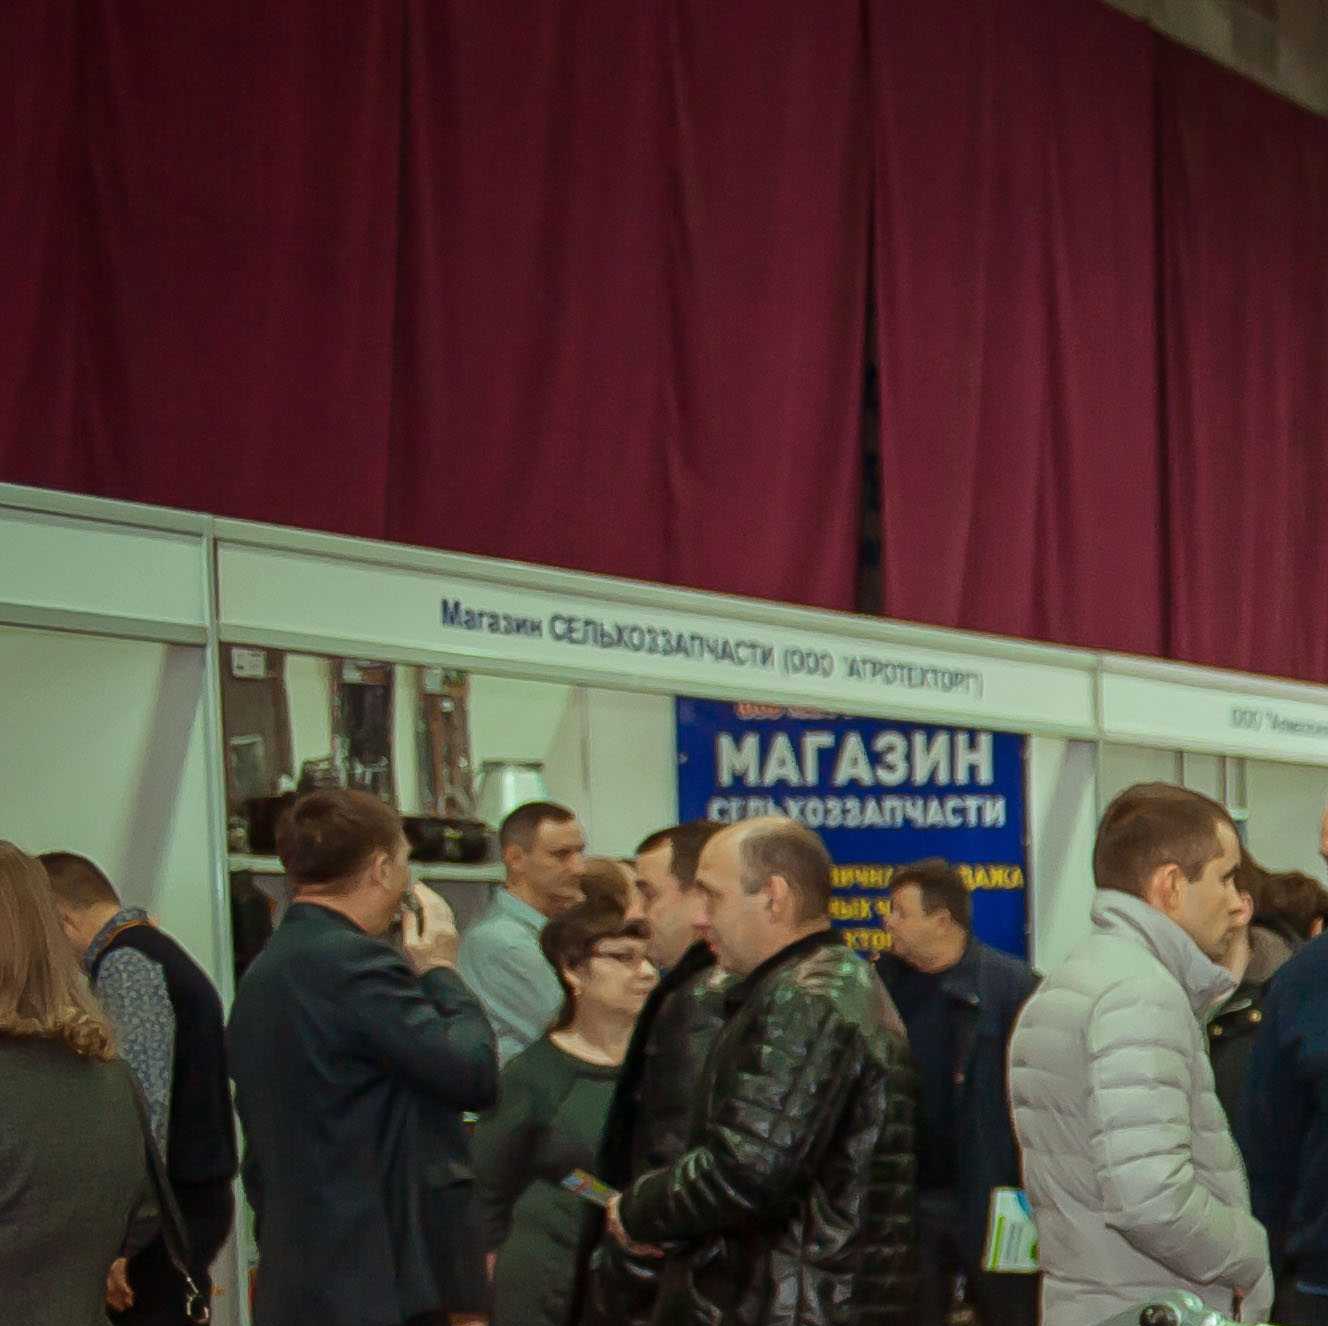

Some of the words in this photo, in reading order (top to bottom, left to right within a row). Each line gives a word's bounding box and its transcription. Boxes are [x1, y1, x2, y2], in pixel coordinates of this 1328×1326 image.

[441, 598, 543, 638] Магазин
[550, 613, 776, 670] СЕЛЬХОЗЗАПЧАСТИ
[783, 648, 836, 679] (ООО
[715, 729, 994, 788] МАГАЗИН
[707, 794, 1007, 830] СЕЛЬХОЗЗАПЧАСТИ
